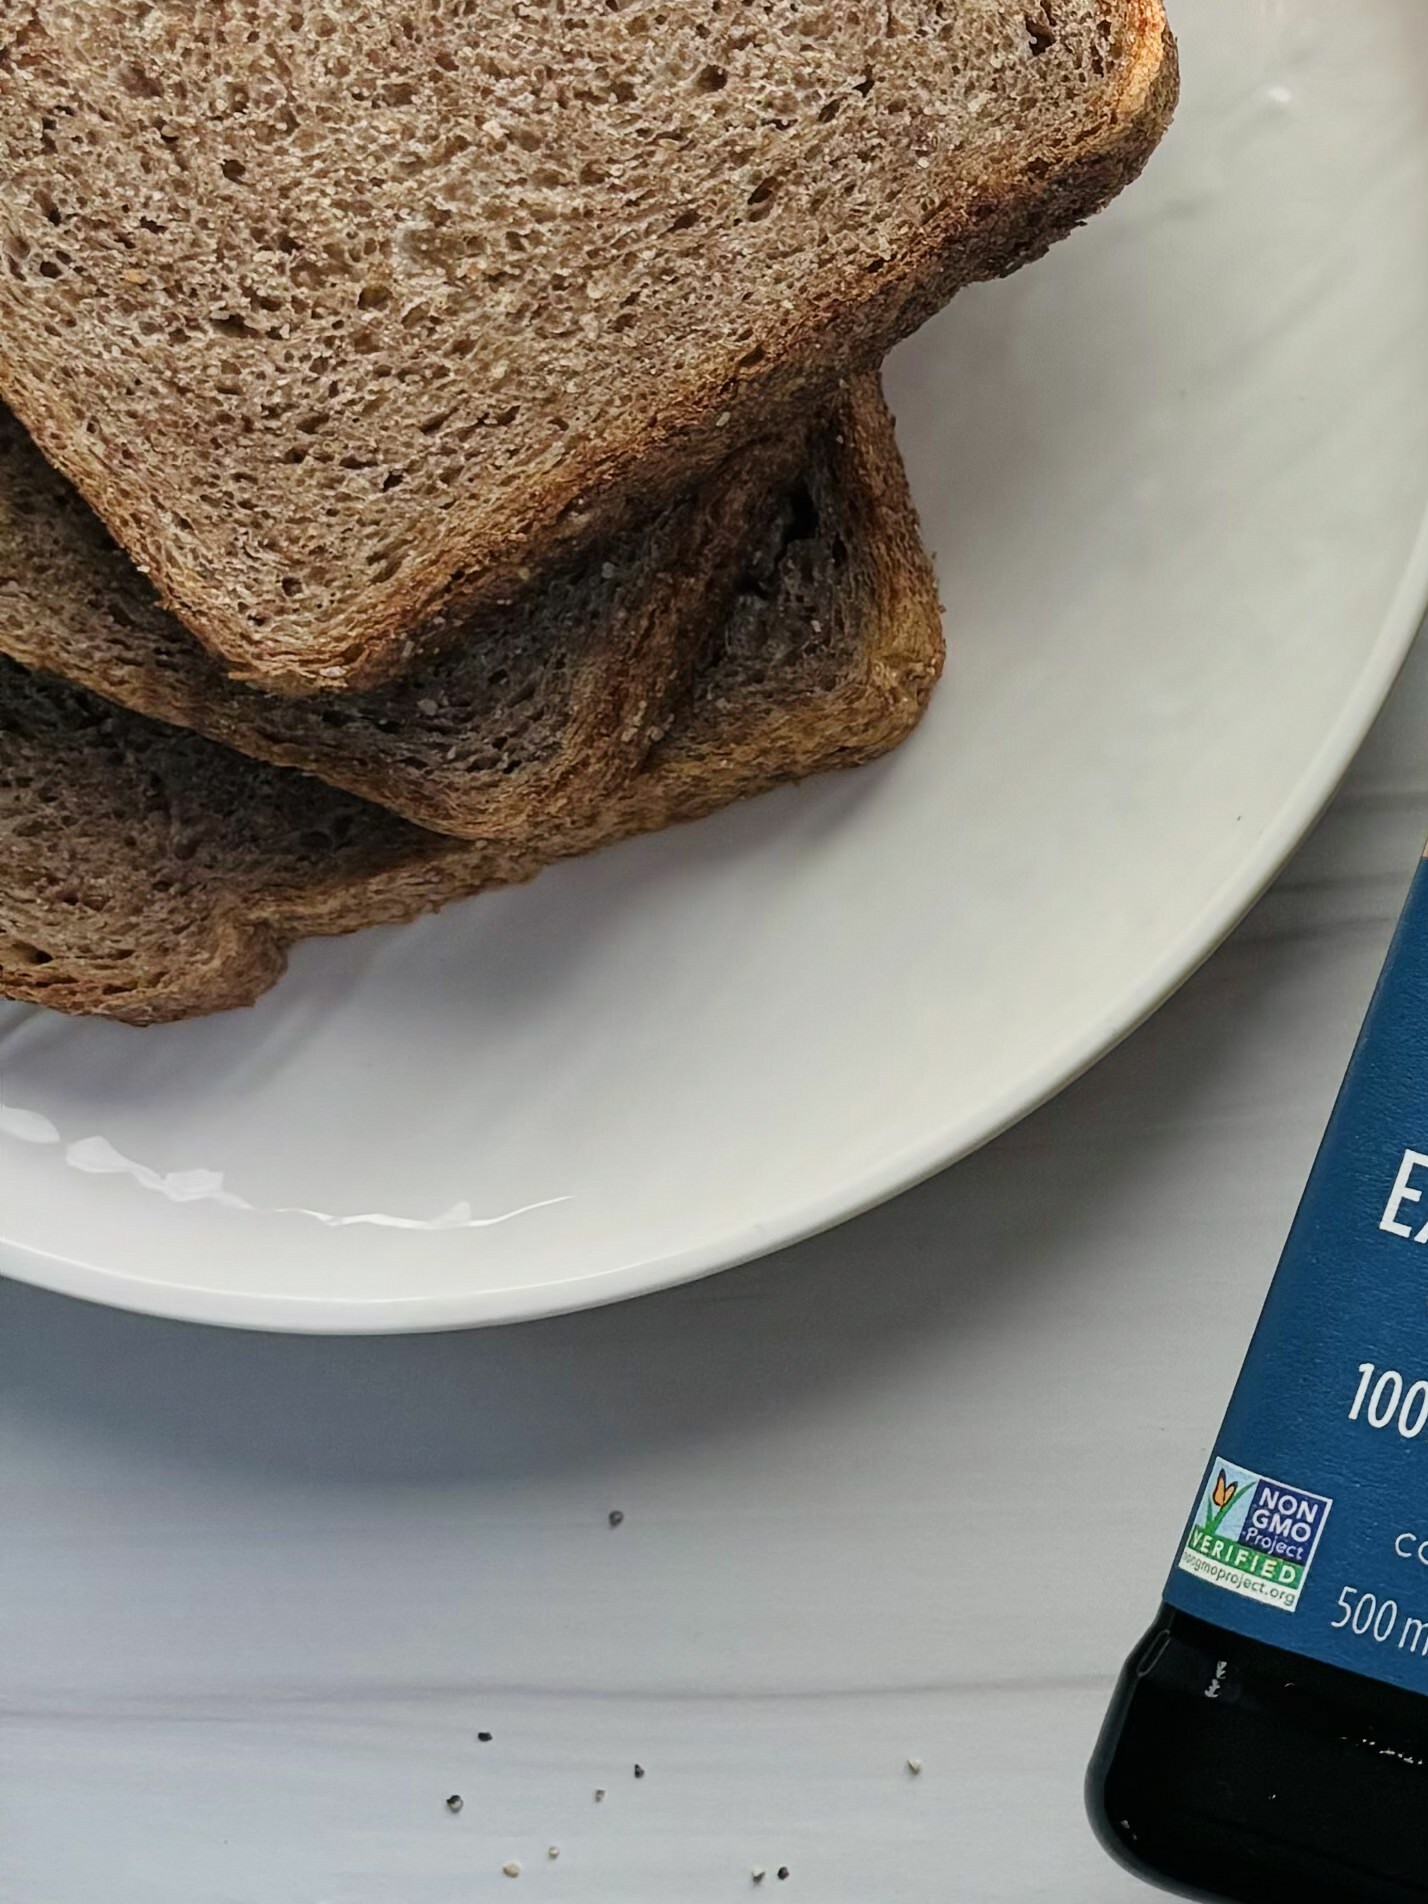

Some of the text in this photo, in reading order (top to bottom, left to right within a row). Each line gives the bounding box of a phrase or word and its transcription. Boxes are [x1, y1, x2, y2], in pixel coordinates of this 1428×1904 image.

[1258, 1486, 1319, 1524] NON
[1244, 1527, 1304, 1561] Project
[1251, 1508, 1312, 1543] GMO
[1190, 1530, 1297, 1585] VERIFIED
[1330, 1585, 1399, 1643] 500
